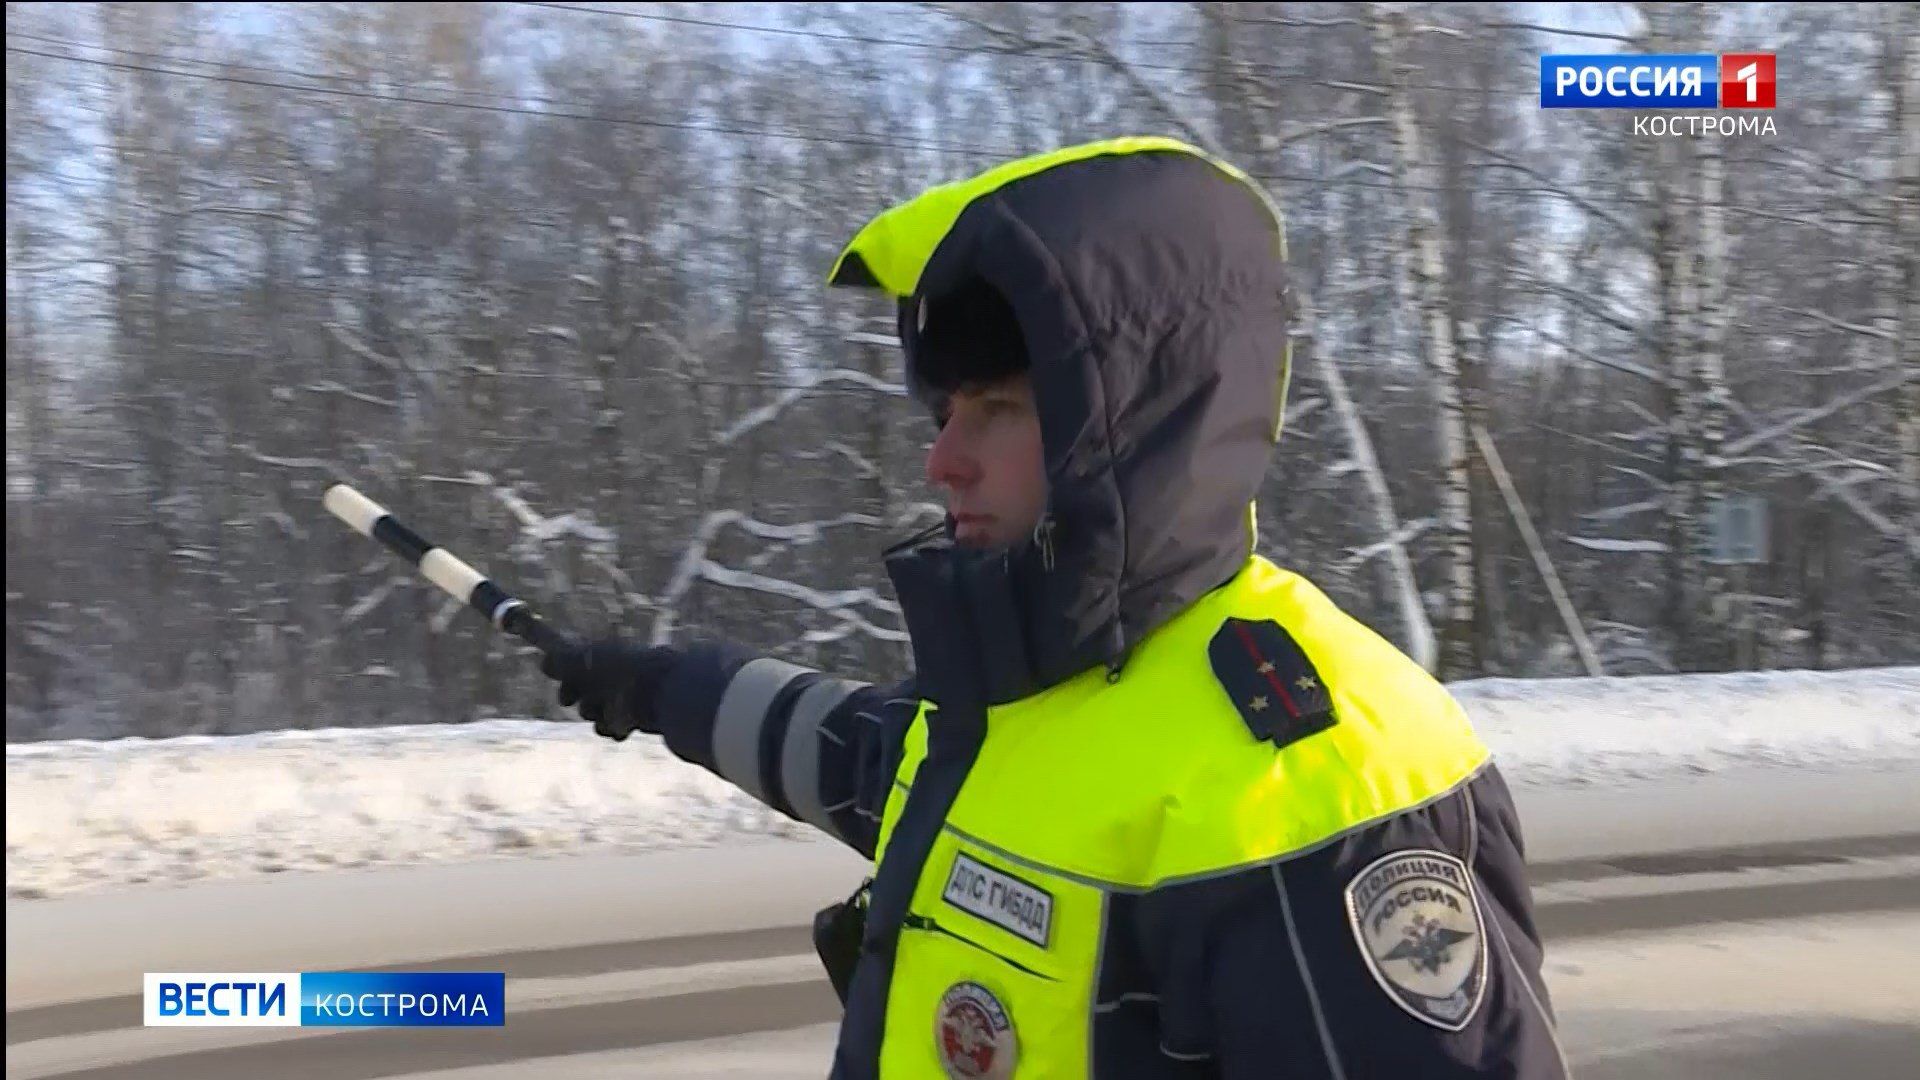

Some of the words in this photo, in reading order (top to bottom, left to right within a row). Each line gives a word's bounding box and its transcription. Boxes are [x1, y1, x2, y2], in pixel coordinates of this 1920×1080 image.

[950, 864, 986, 899] ДПС
[989, 880, 1046, 932] ГИБДД
[1356, 860, 1459, 909] ПОЛИЦИЯ
[1373, 887, 1462, 935] РОССИЯ
